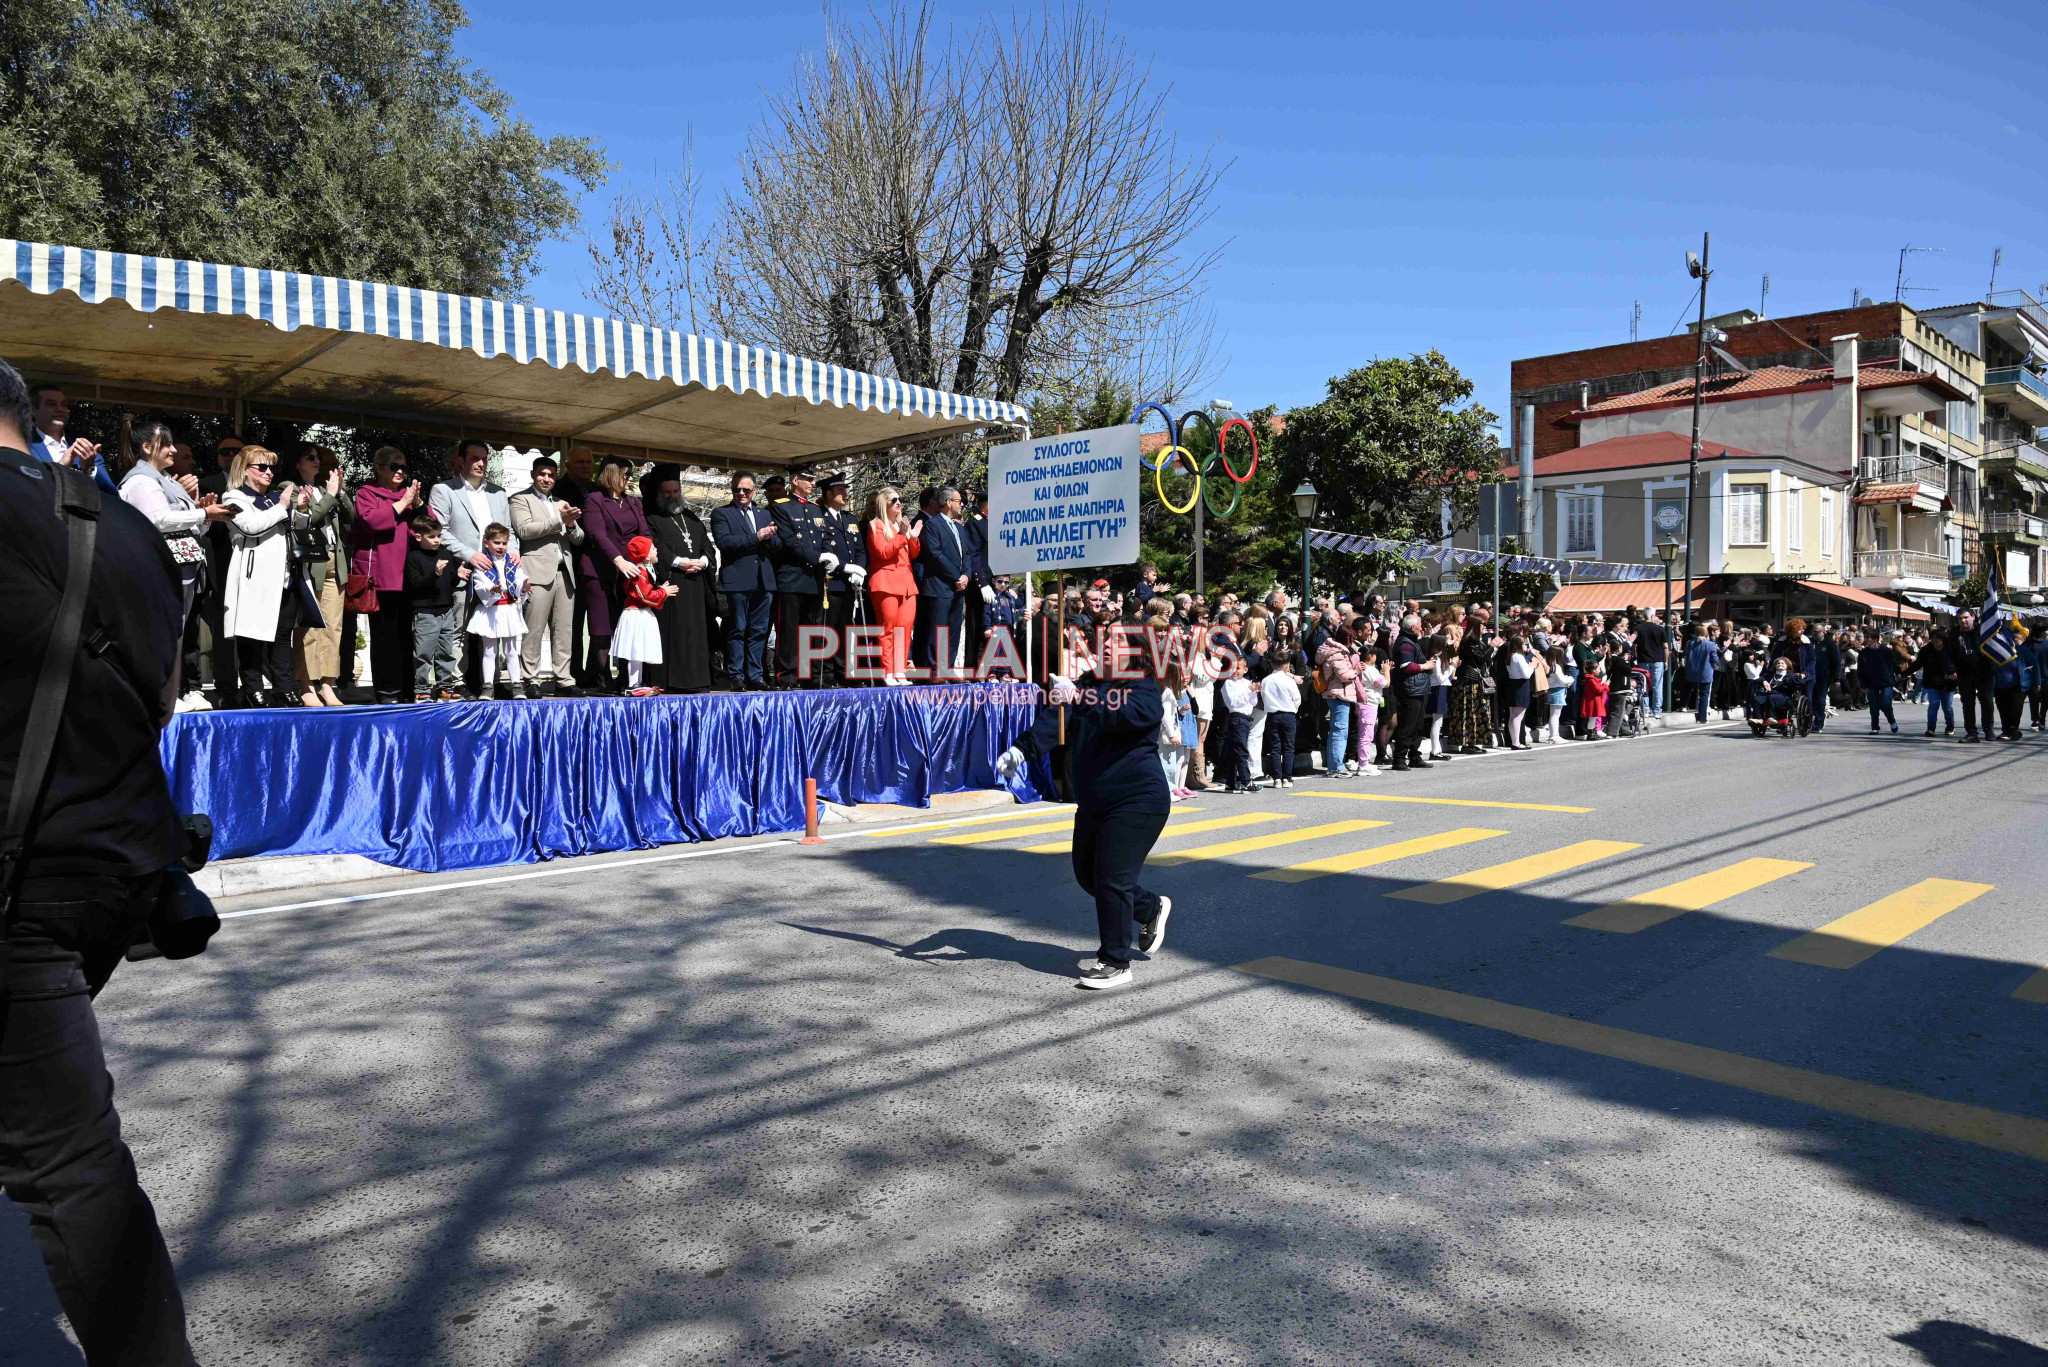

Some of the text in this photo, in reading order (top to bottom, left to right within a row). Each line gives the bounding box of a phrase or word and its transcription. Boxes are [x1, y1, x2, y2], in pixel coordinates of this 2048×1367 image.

[1034, 440, 1091, 460] ΣΥΛΛΟΓΟΣ
[1005, 456, 1123, 485] ΓΟΝΕΩΝ-ΚΗΔΕΜΟΝΩΝ
[1034, 481, 1089, 501] ΚΑΙ ΦΙΛΩΝ
[1002, 499, 1125, 525] ΑΤΟΜΩΝ ΜΕ ΑΝΑΠΗΡΙΑ
[1036, 544, 1085, 562] ΣΚΥΔΡΑΣ
